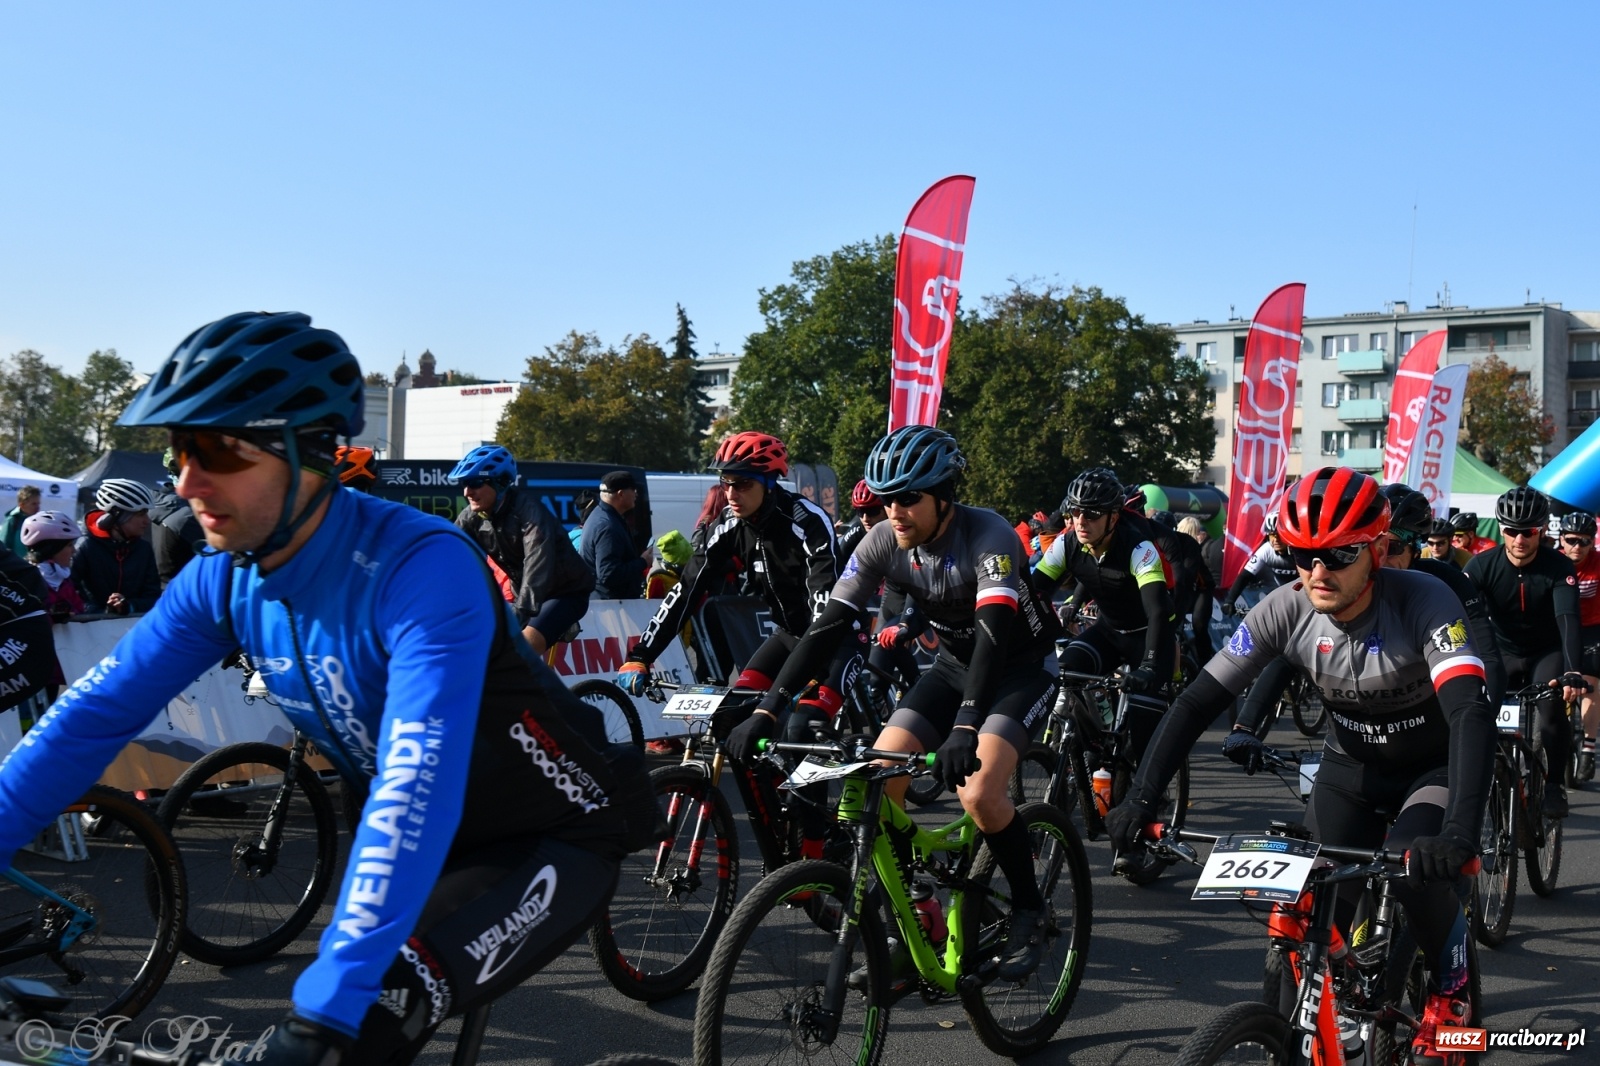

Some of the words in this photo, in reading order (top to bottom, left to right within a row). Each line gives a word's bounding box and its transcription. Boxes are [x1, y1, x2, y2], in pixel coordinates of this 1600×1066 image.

[420, 468, 460, 486] bike
[0, 638, 28, 666] BIKE
[0, 673, 31, 698] AM
[1331, 675, 1430, 700] ROWEREK
[675, 699, 712, 711] 1354
[1332, 711, 1382, 735] ROWEROWY
[1387, 715, 1426, 734] BYTOM
[1363, 734, 1387, 744] TEAM
[402, 715, 444, 852] ELEKTRONIK
[333, 717, 427, 950] WEILANDT
[1215, 859, 1291, 880] 2667
[463, 893, 543, 961] WEILANDT
